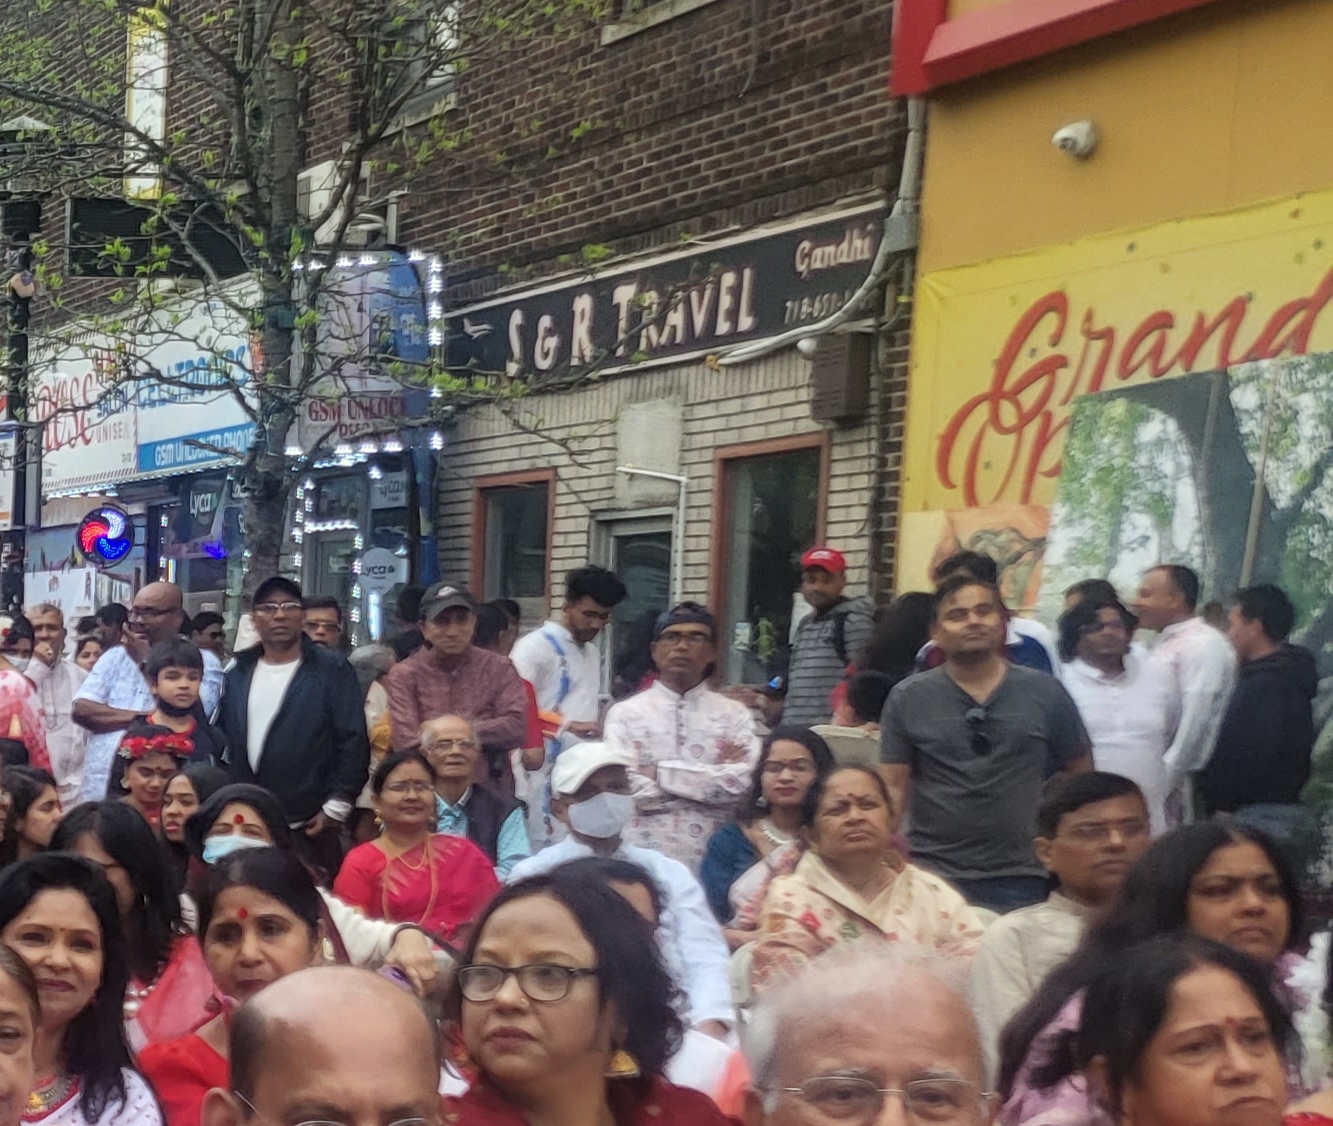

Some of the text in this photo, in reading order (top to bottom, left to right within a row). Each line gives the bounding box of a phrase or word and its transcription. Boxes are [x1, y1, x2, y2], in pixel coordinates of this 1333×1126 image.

[794, 223, 875, 280] Gandhi
[505, 307, 526, 377] S
[569, 292, 595, 366] R
[612, 267, 755, 358] TRAVEL
[989, 262, 1333, 436] Grand
[96, 425, 131, 443] UNISEX
[155, 446, 174, 467] GSM
[190, 491, 212, 518] Lyca
